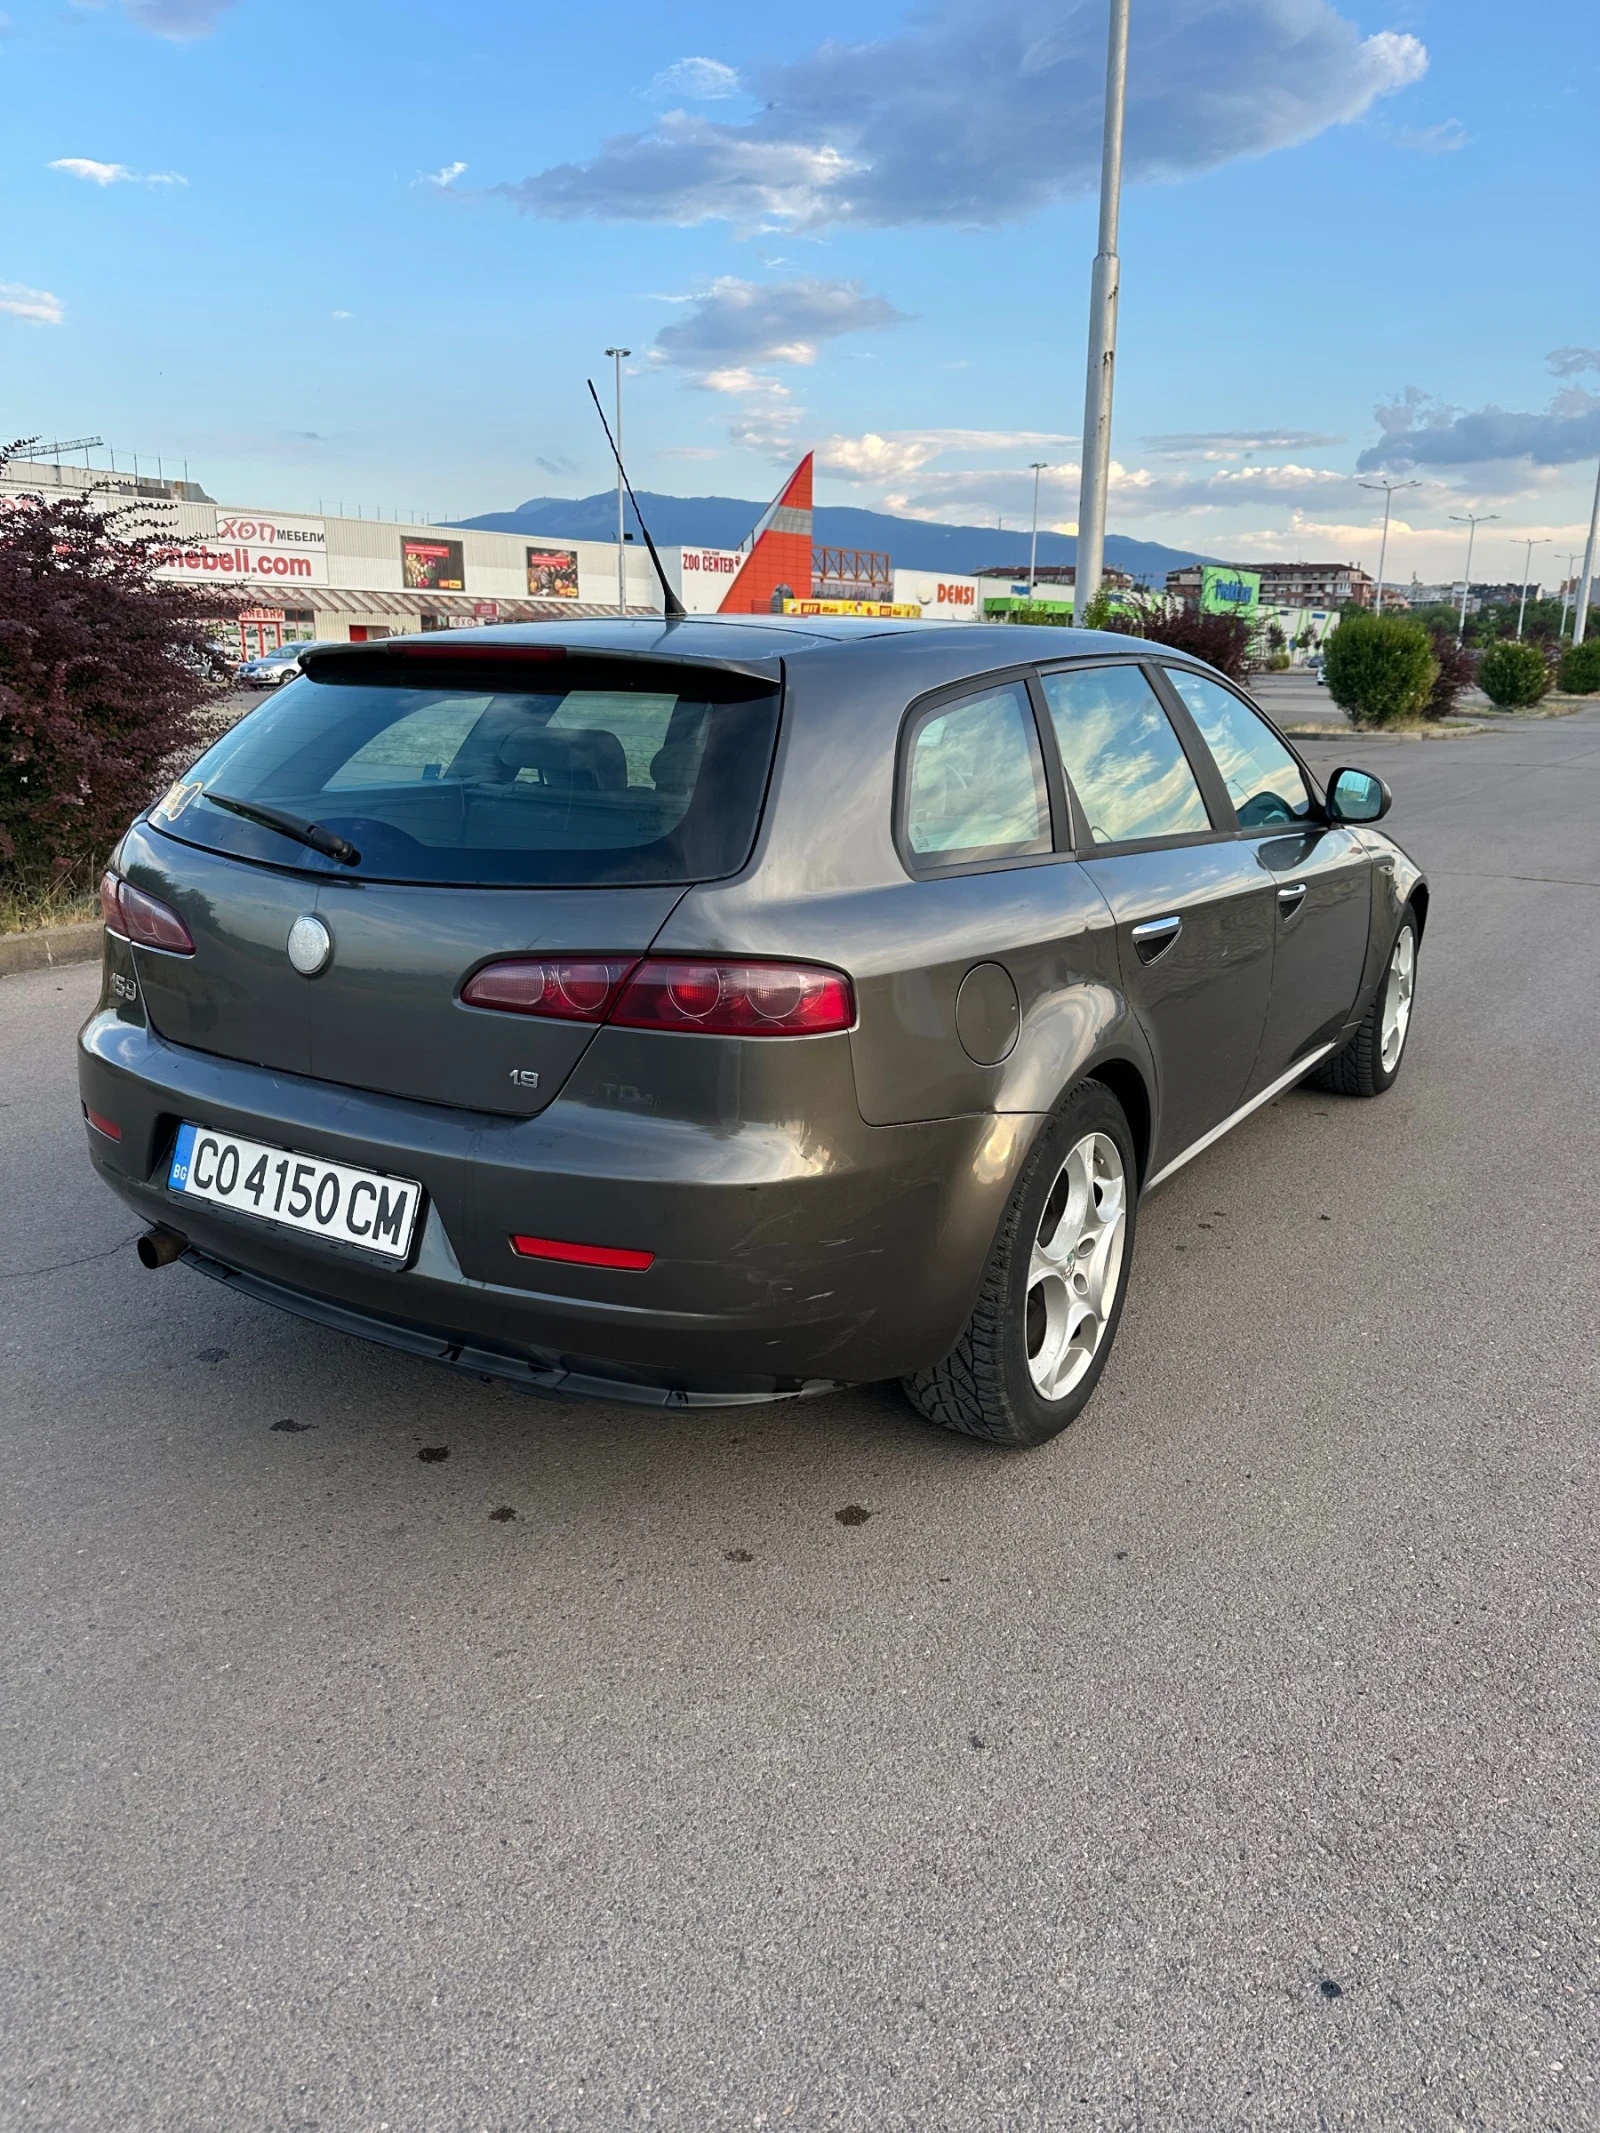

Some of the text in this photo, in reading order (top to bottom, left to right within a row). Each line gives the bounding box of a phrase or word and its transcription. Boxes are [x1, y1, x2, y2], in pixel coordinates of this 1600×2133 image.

[220, 518, 325, 543] ХОП МЕБЕЛИ
[683, 553, 735, 574] ZOO CENTER
[937, 583, 975, 606] DENSI
[241, 608, 284, 619] ДНЕВНИ
[803, 604, 818, 613] HIT
[173, 1163, 187, 1181] BG
[244, 1154, 340, 1225] 4150
